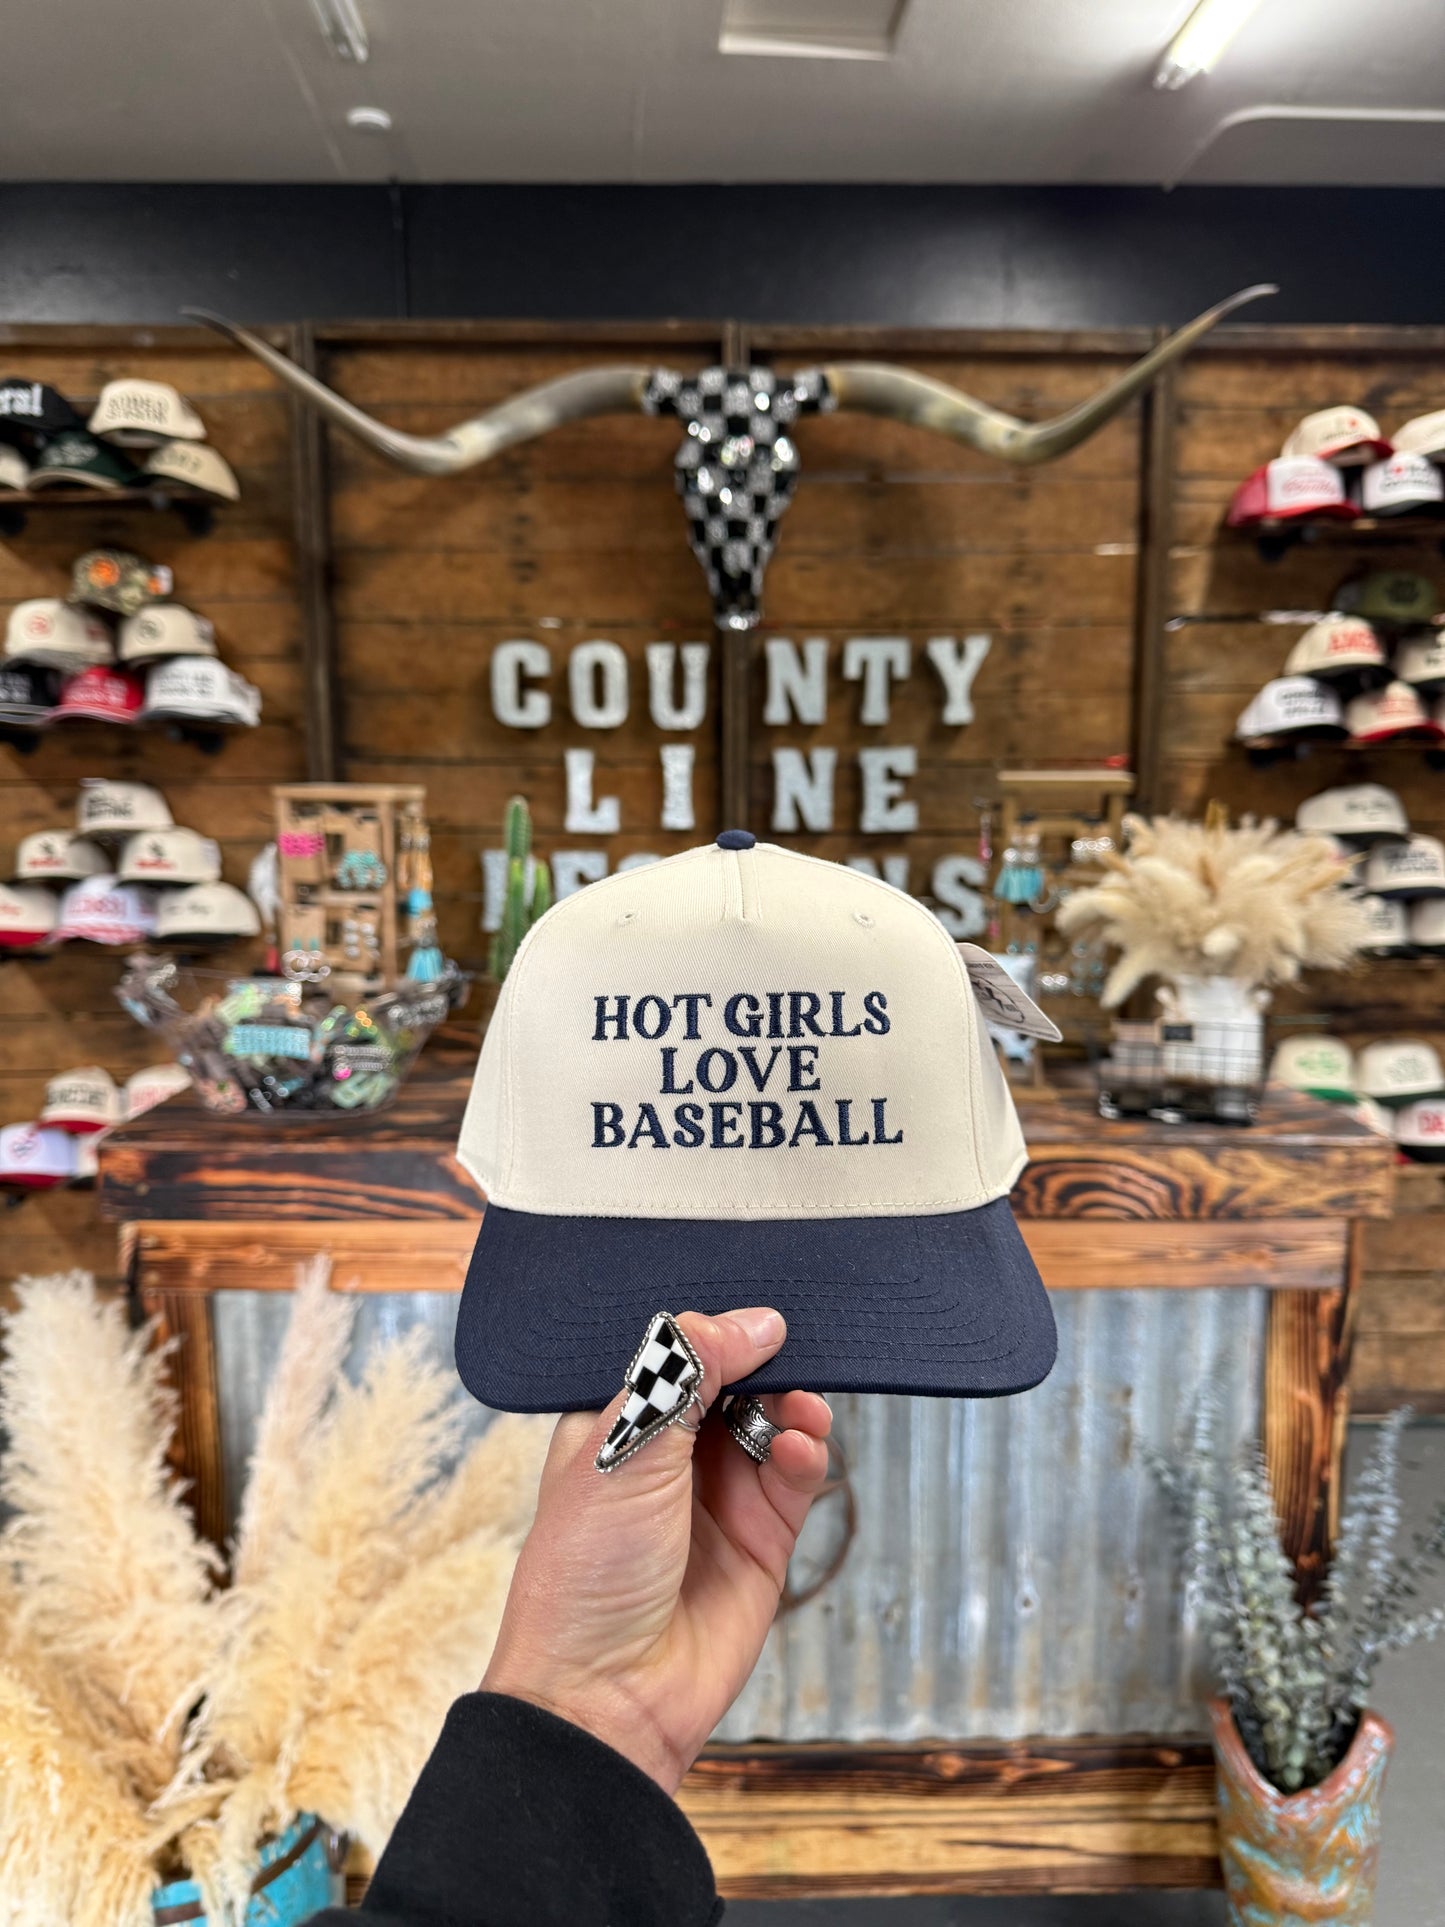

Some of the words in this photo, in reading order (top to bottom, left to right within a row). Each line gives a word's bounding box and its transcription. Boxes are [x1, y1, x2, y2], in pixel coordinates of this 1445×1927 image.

[490, 635, 992, 731] COUNTY
[564, 744, 919, 834] LINE
[592, 994, 712, 1040] HOT
[724, 991, 891, 1038] GIRLS
[660, 1045, 821, 1094] LOVE
[591, 1097, 903, 1148] BASEBALL
